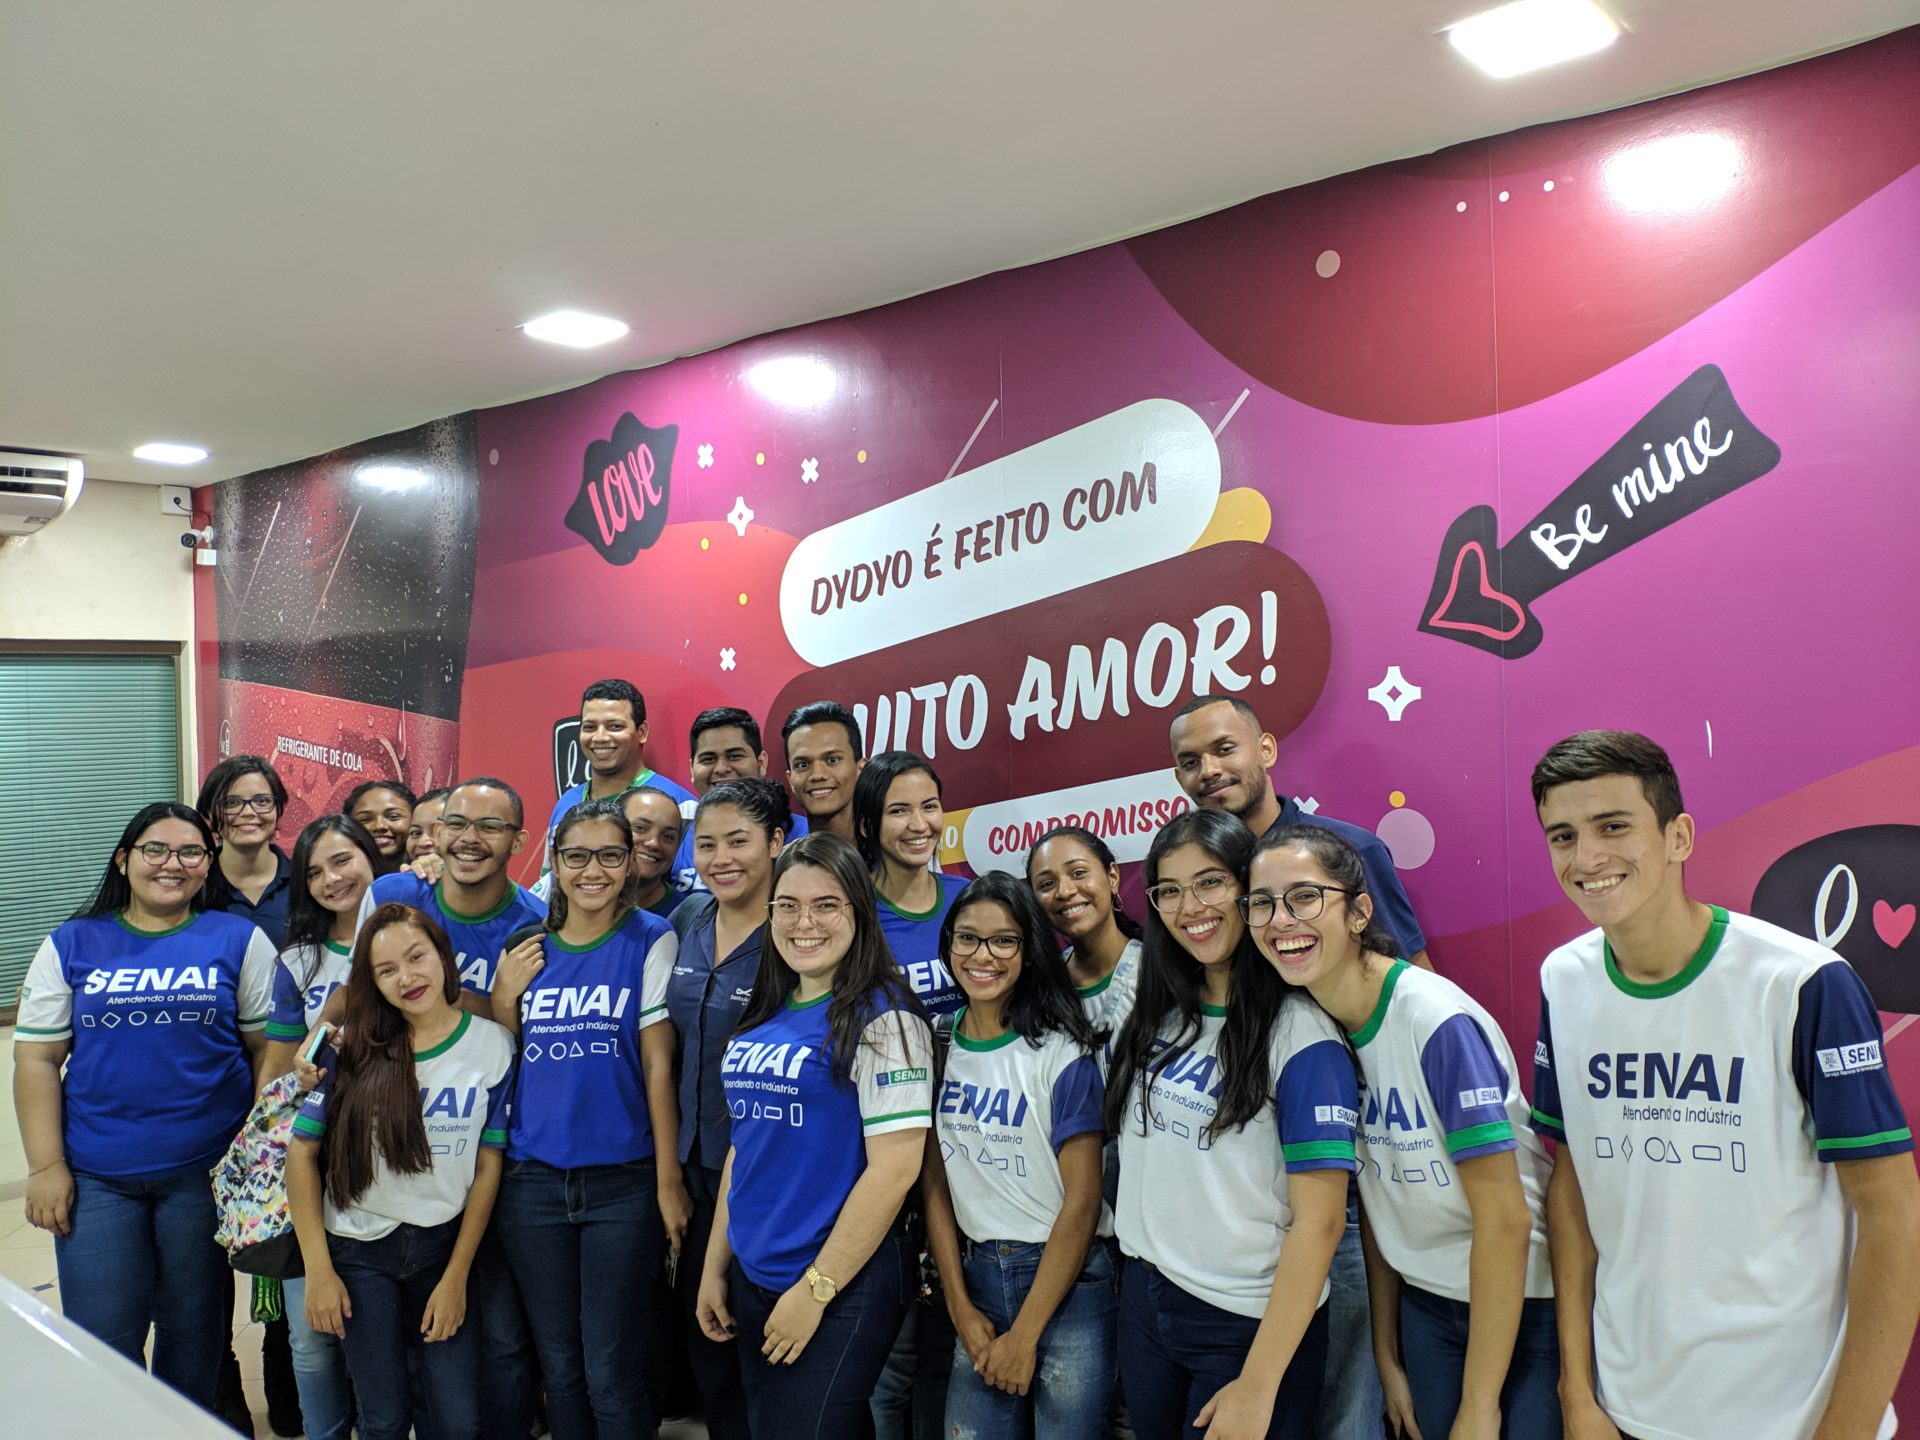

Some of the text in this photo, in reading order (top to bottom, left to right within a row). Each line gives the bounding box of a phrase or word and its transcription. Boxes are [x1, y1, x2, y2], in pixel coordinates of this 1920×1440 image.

[1530, 416, 1734, 569] Be mine
[810, 461, 1157, 615] DYDYO É FEITO COM
[853, 589, 1279, 760] UITO AMOR!
[277, 735, 363, 772] REFRIGERANTE DE COLA
[84, 966, 218, 995] SENAI
[106, 993, 165, 1006] Atendendo
[721, 1040, 813, 1079] ENAI
[893, 1069, 925, 1082] SENAI
[761, 1080, 799, 1095] Indústria
[1587, 1052, 1745, 1104] SENAI
[939, 1080, 1028, 1127] ENAI
[1171, 1092, 1216, 1117] Indústria
[1685, 1106, 1742, 1127] Indústria
[428, 1122, 471, 1133] Indústria
